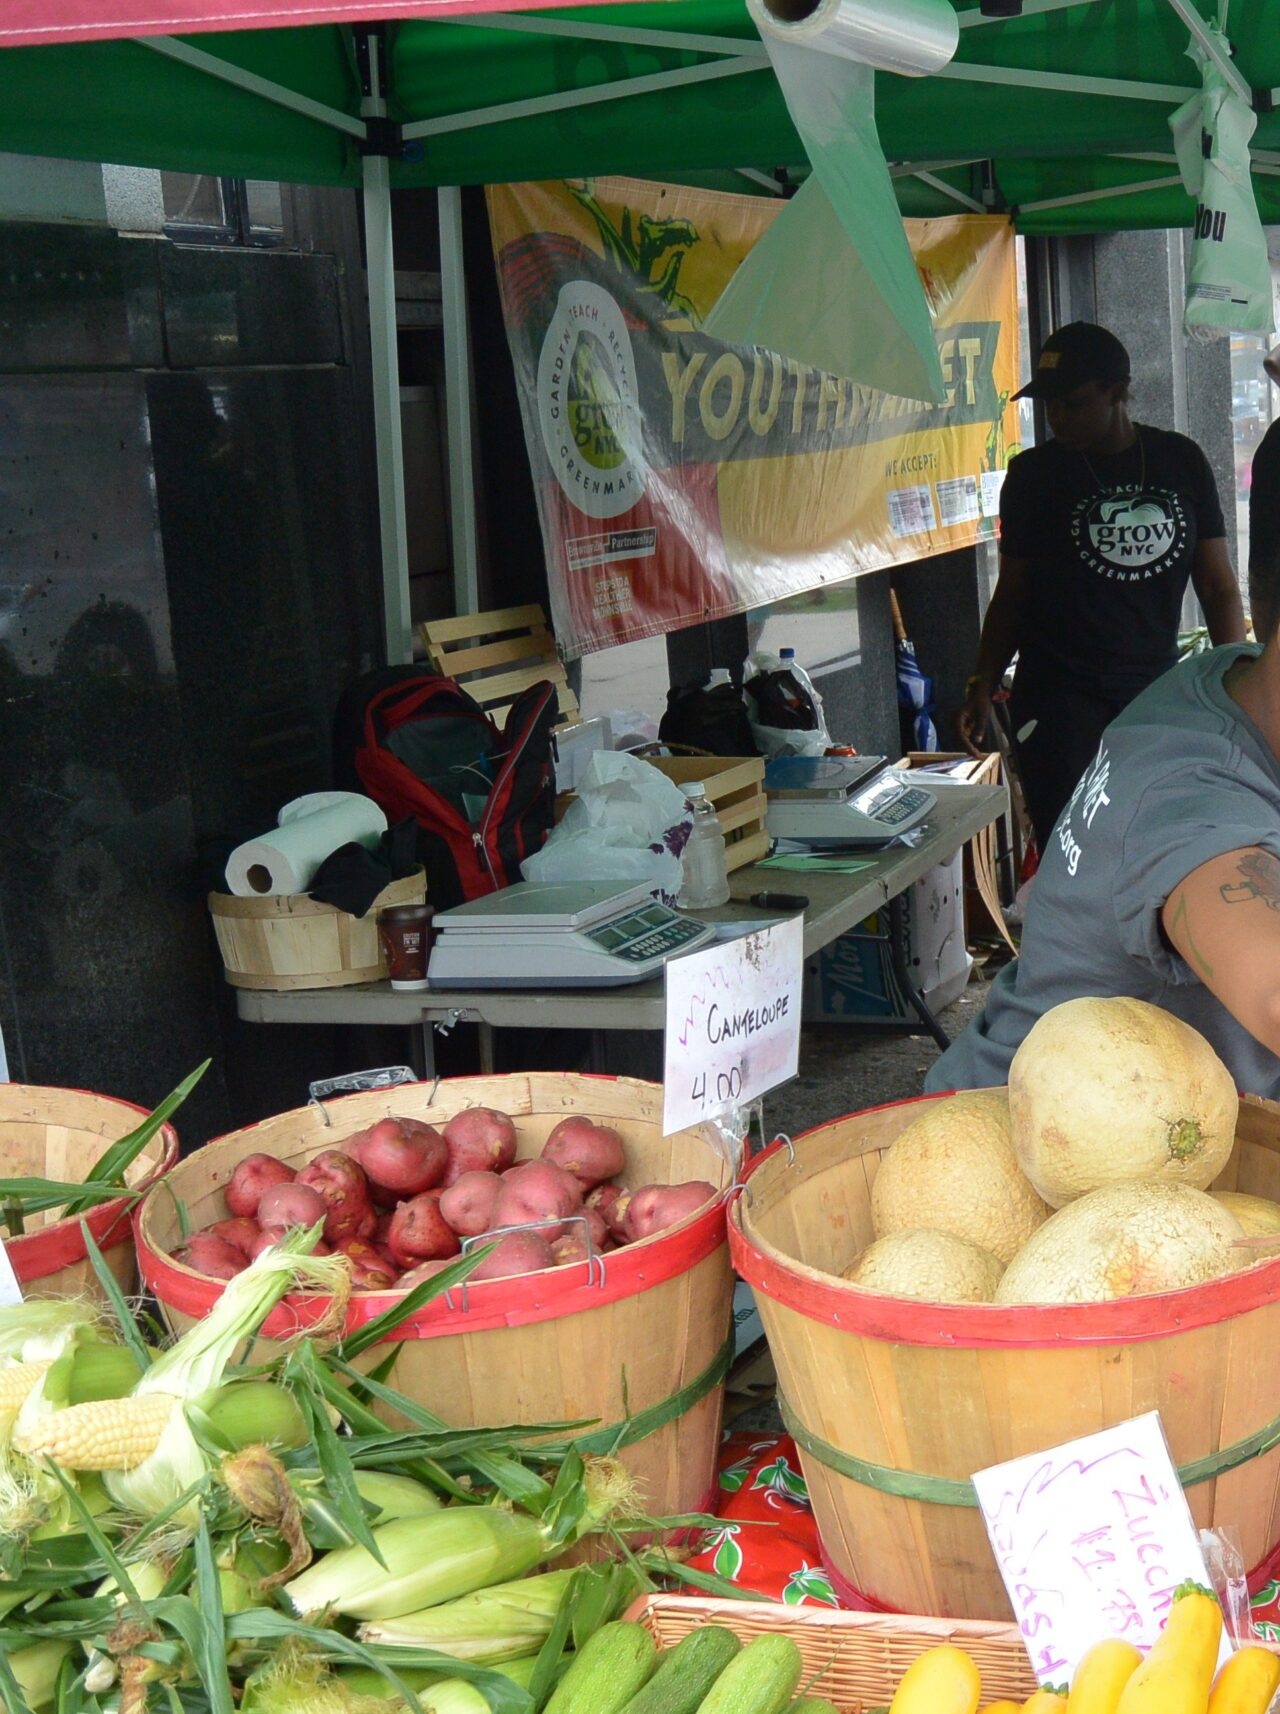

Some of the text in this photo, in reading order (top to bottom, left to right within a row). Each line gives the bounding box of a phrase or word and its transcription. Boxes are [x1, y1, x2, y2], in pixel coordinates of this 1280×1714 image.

[568, 304, 599, 322] TEACH
[550, 327, 572, 420] GARDEN
[884, 452, 937, 477] WE ACCEPT:
[611, 533, 654, 550] Partnership
[1095, 522, 1175, 553] grow
[1120, 543, 1155, 556] NYC
[1079, 541, 1185, 582] GREENMARKET
[691, 1066, 743, 1110] 4.00
[1112, 1474, 1178, 1633] Zucch
